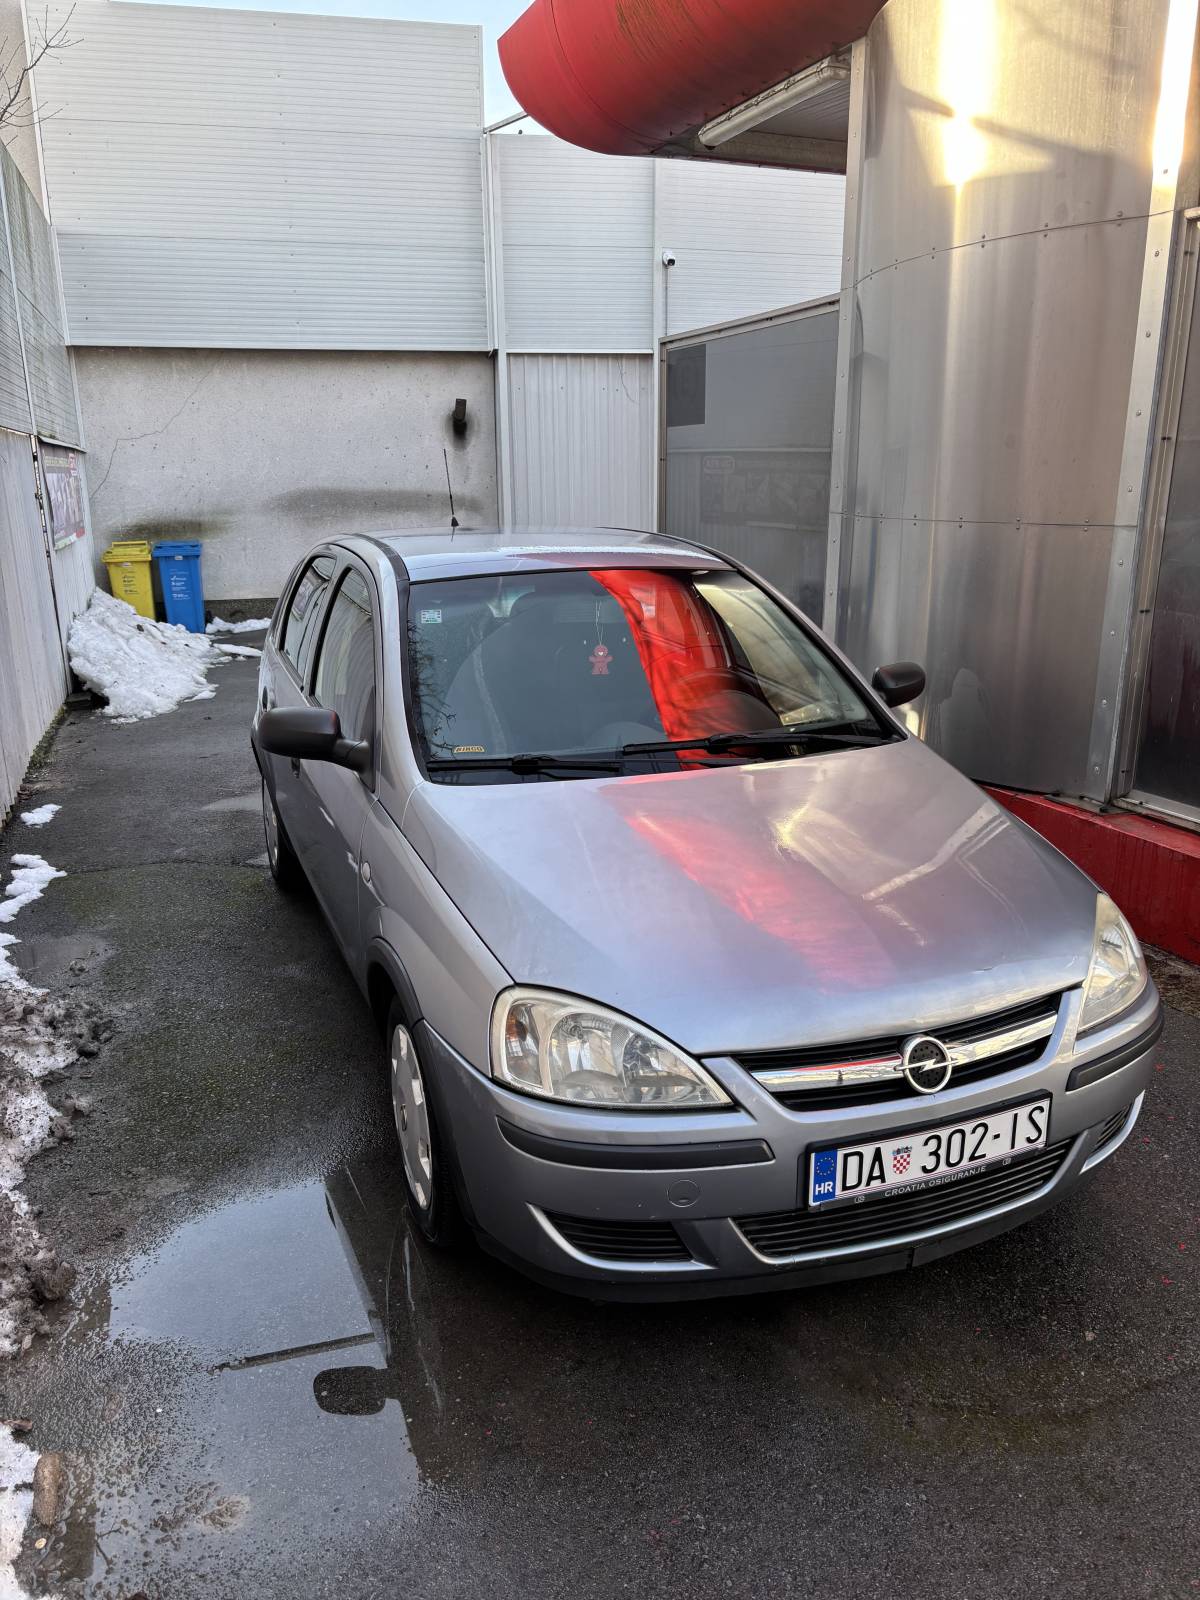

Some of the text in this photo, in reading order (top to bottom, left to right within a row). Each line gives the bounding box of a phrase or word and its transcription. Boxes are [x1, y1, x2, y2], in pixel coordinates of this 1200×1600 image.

[841, 1105, 1045, 1192] DA 302-IS
[815, 1181, 834, 1195] HR
[884, 1165, 987, 1197] CROATIA OSIGURANJE
